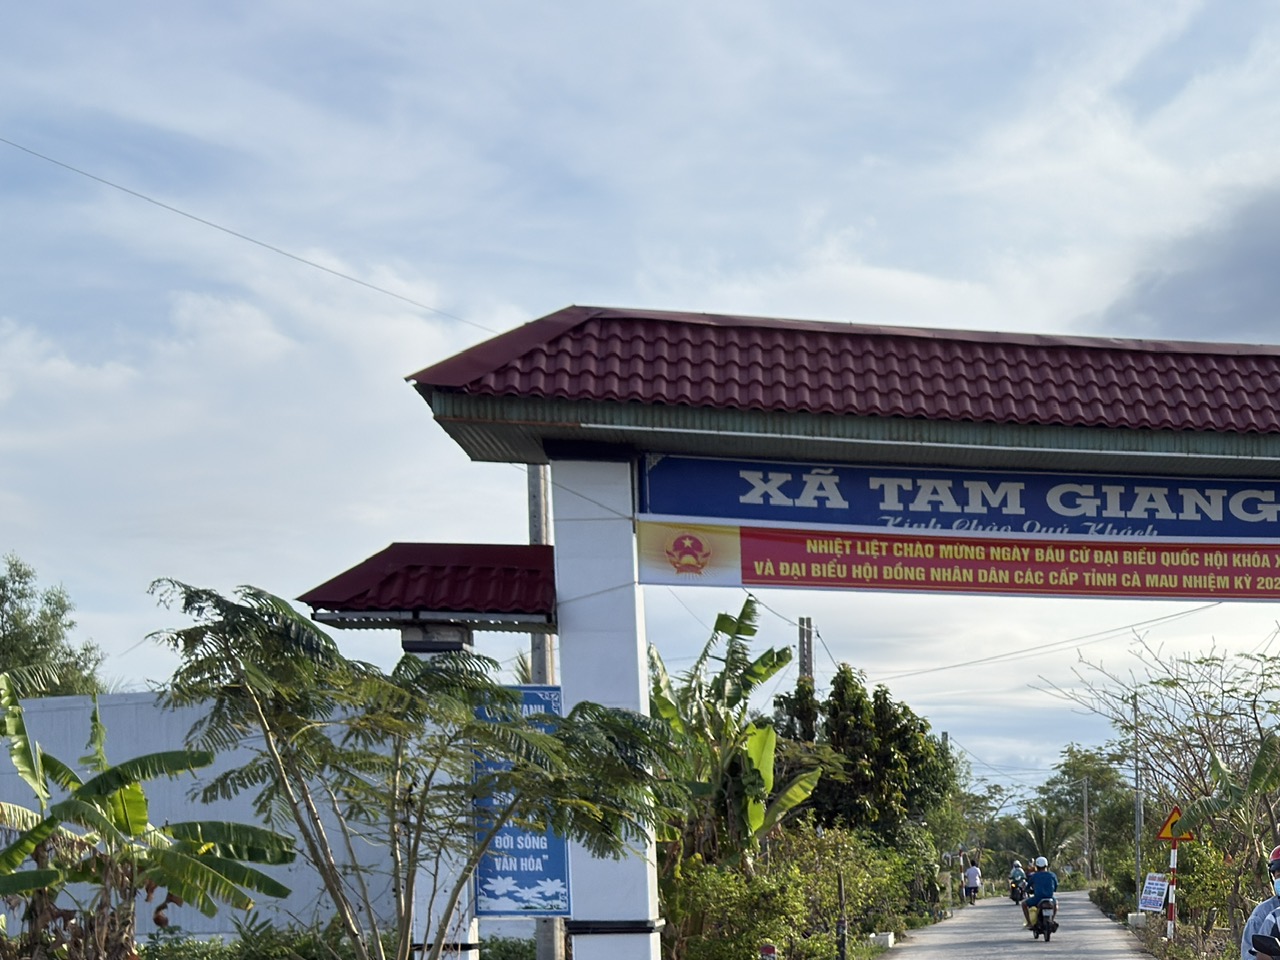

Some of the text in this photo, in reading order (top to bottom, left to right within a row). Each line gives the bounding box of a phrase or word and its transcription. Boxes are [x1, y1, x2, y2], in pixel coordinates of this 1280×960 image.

[739, 468, 1280, 522] XÃ TAM GIANG
[806, 538, 852, 558] NHIỆT
[857, 539, 888, 559] LIỆT
[893, 541, 934, 559] CHÀO
[939, 542, 985, 560] MỪNG
[990, 544, 1030, 562] NGÀY
[1069, 546, 1091, 564] CỬ
[1093, 550, 1118, 568] ĐẠI
[1123, 546, 1157, 566] BIỂU
[1160, 548, 1200, 568] QUỐC
[1204, 551, 1228, 570] HỘI
[1232, 551, 1271, 569] KHÓA
[754, 558, 775, 577] VÀ
[779, 562, 806, 580] ĐẠI
[811, 558, 847, 579] BIỂU
[852, 562, 878, 582] HỘI
[883, 561, 926, 581] ĐỒNG
[930, 565, 974, 583] NHÂN
[978, 566, 1010, 584] DÂN
[1014, 568, 1045, 585] CÁC
[1048, 567, 1079, 586] CẤP
[1083, 568, 1117, 587] TỈNH
[1121, 571, 1142, 588] CÀ
[1145, 574, 1178, 589] MAU
[1182, 573, 1230, 592] NHIỆM
[1234, 574, 1252, 590] KỲ
[494, 831, 548, 849] ĐỜI SỐNG
